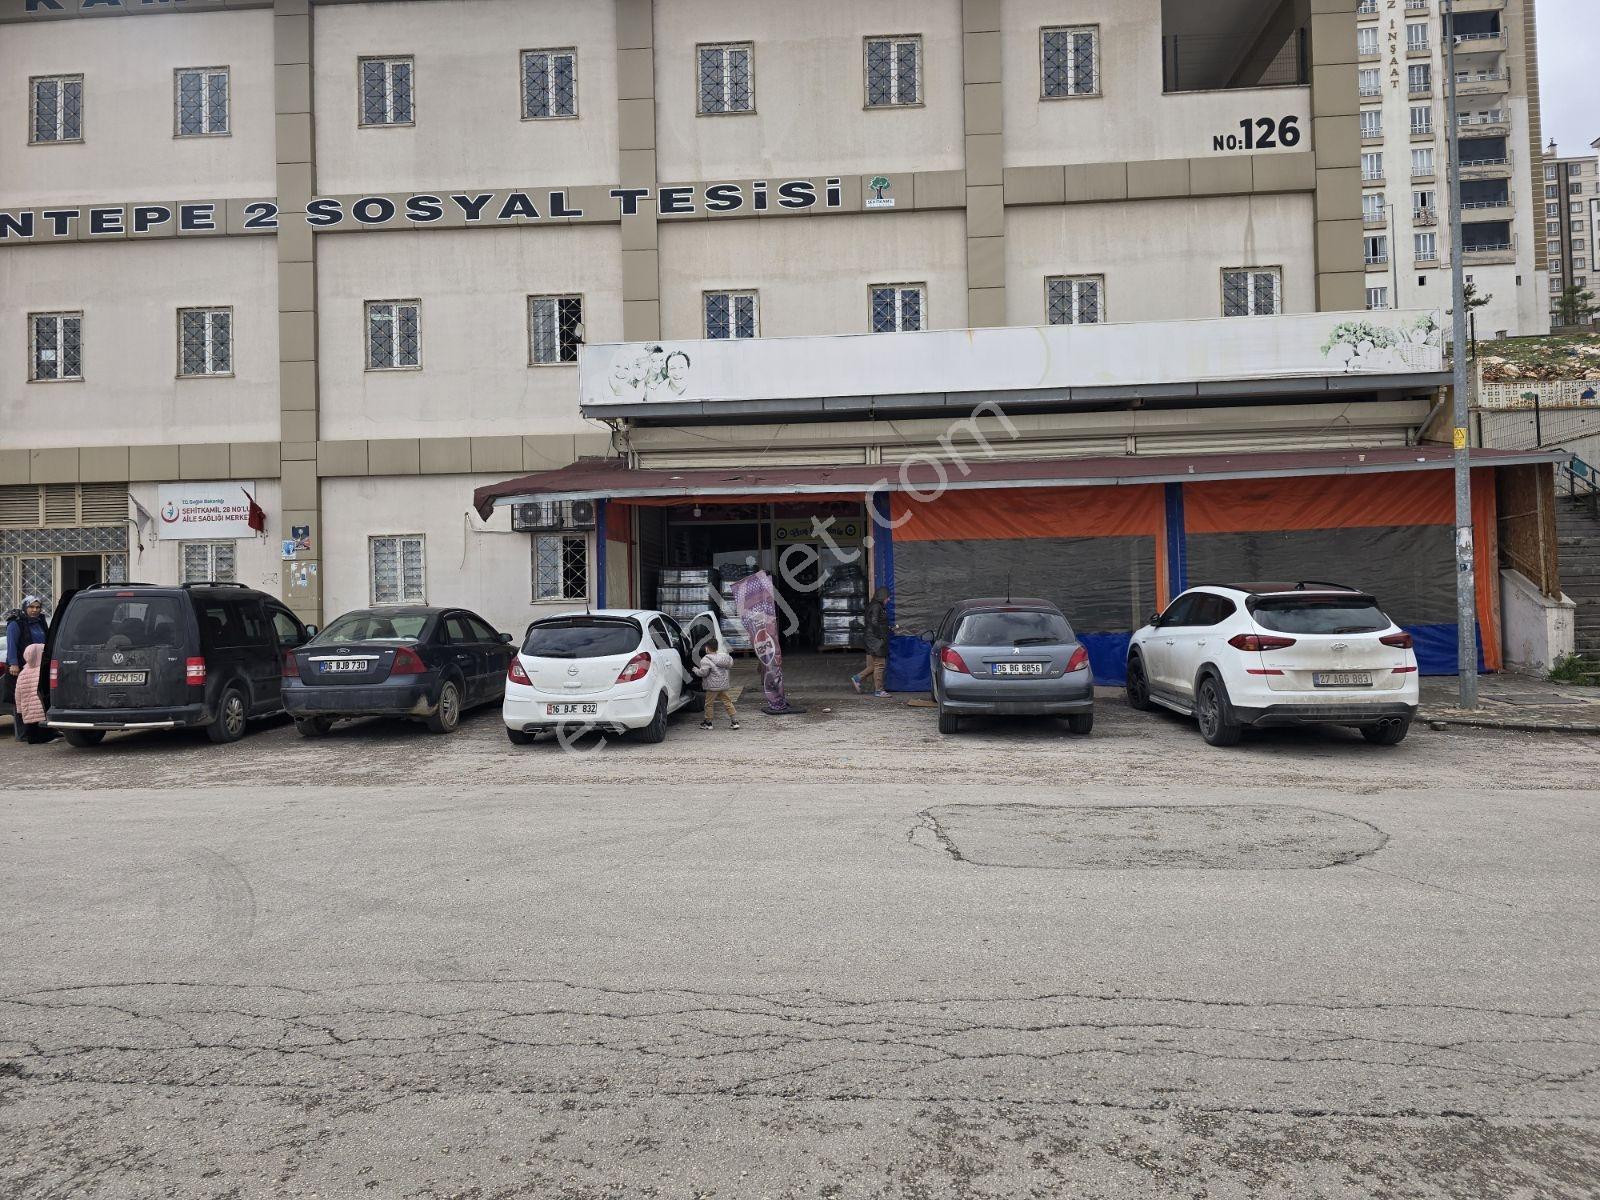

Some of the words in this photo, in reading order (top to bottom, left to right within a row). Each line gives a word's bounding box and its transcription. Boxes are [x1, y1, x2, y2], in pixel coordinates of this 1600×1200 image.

[243, 202, 279, 229] 2
[305, 191, 584, 226] SOSYAL
[225, 514, 250, 522] MERKE
[324, 661, 333, 670] 06
[336, 661, 350, 670] BJB
[351, 661, 366, 669] 730
[997, 664, 1007, 672] 06
[1009, 664, 1019, 672] BG
[1021, 664, 1041, 672] 8856
[98, 674, 109, 683] 27
[110, 673, 128, 682] BCM
[130, 673, 144, 682] 150
[1319, 674, 1330, 684] 27
[552, 705, 560, 713] 16
[564, 705, 577, 713] BJE
[582, 705, 595, 713] 832
